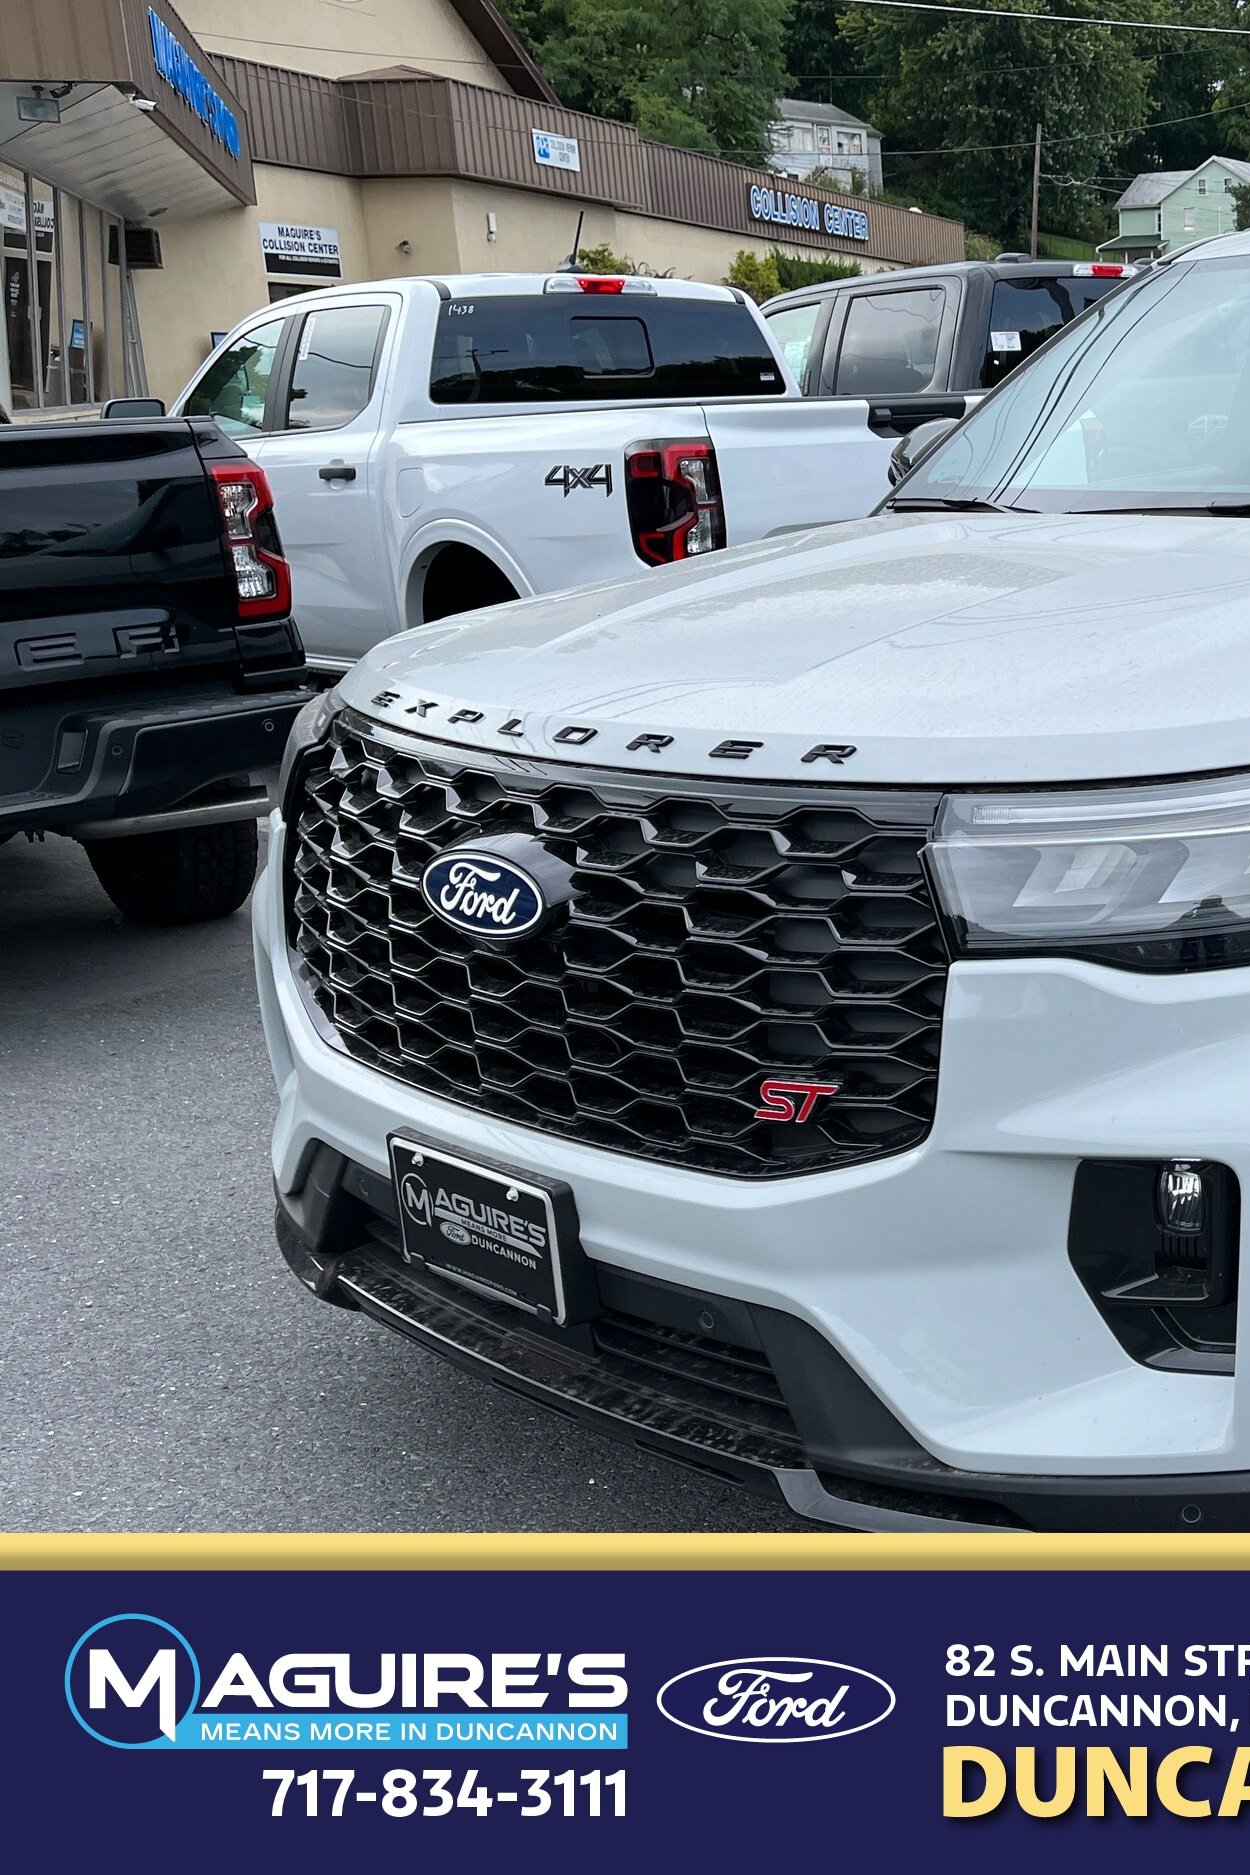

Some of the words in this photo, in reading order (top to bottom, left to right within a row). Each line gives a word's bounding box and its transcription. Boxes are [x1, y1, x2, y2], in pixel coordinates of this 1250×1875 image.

[750, 185, 819, 231] COLLISION
[824, 203, 869, 240] CENTER
[262, 238, 306, 253] COLLISION
[308, 242, 339, 255] CENTER
[277, 226, 322, 241] MAGUIRE'S
[448, 304, 475, 316] 1438
[545, 464, 614, 498] 4x4
[371, 690, 859, 765] EXPLORER
[440, 861, 521, 926] Ford
[753, 1080, 840, 1123] ST
[404, 1182, 546, 1249] MAGUIRE'S
[460, 1218, 485, 1234] MEANS
[486, 1228, 508, 1243] MORE
[445, 1226, 465, 1243] Ford
[470, 1234, 537, 1271] DUNCANNON
